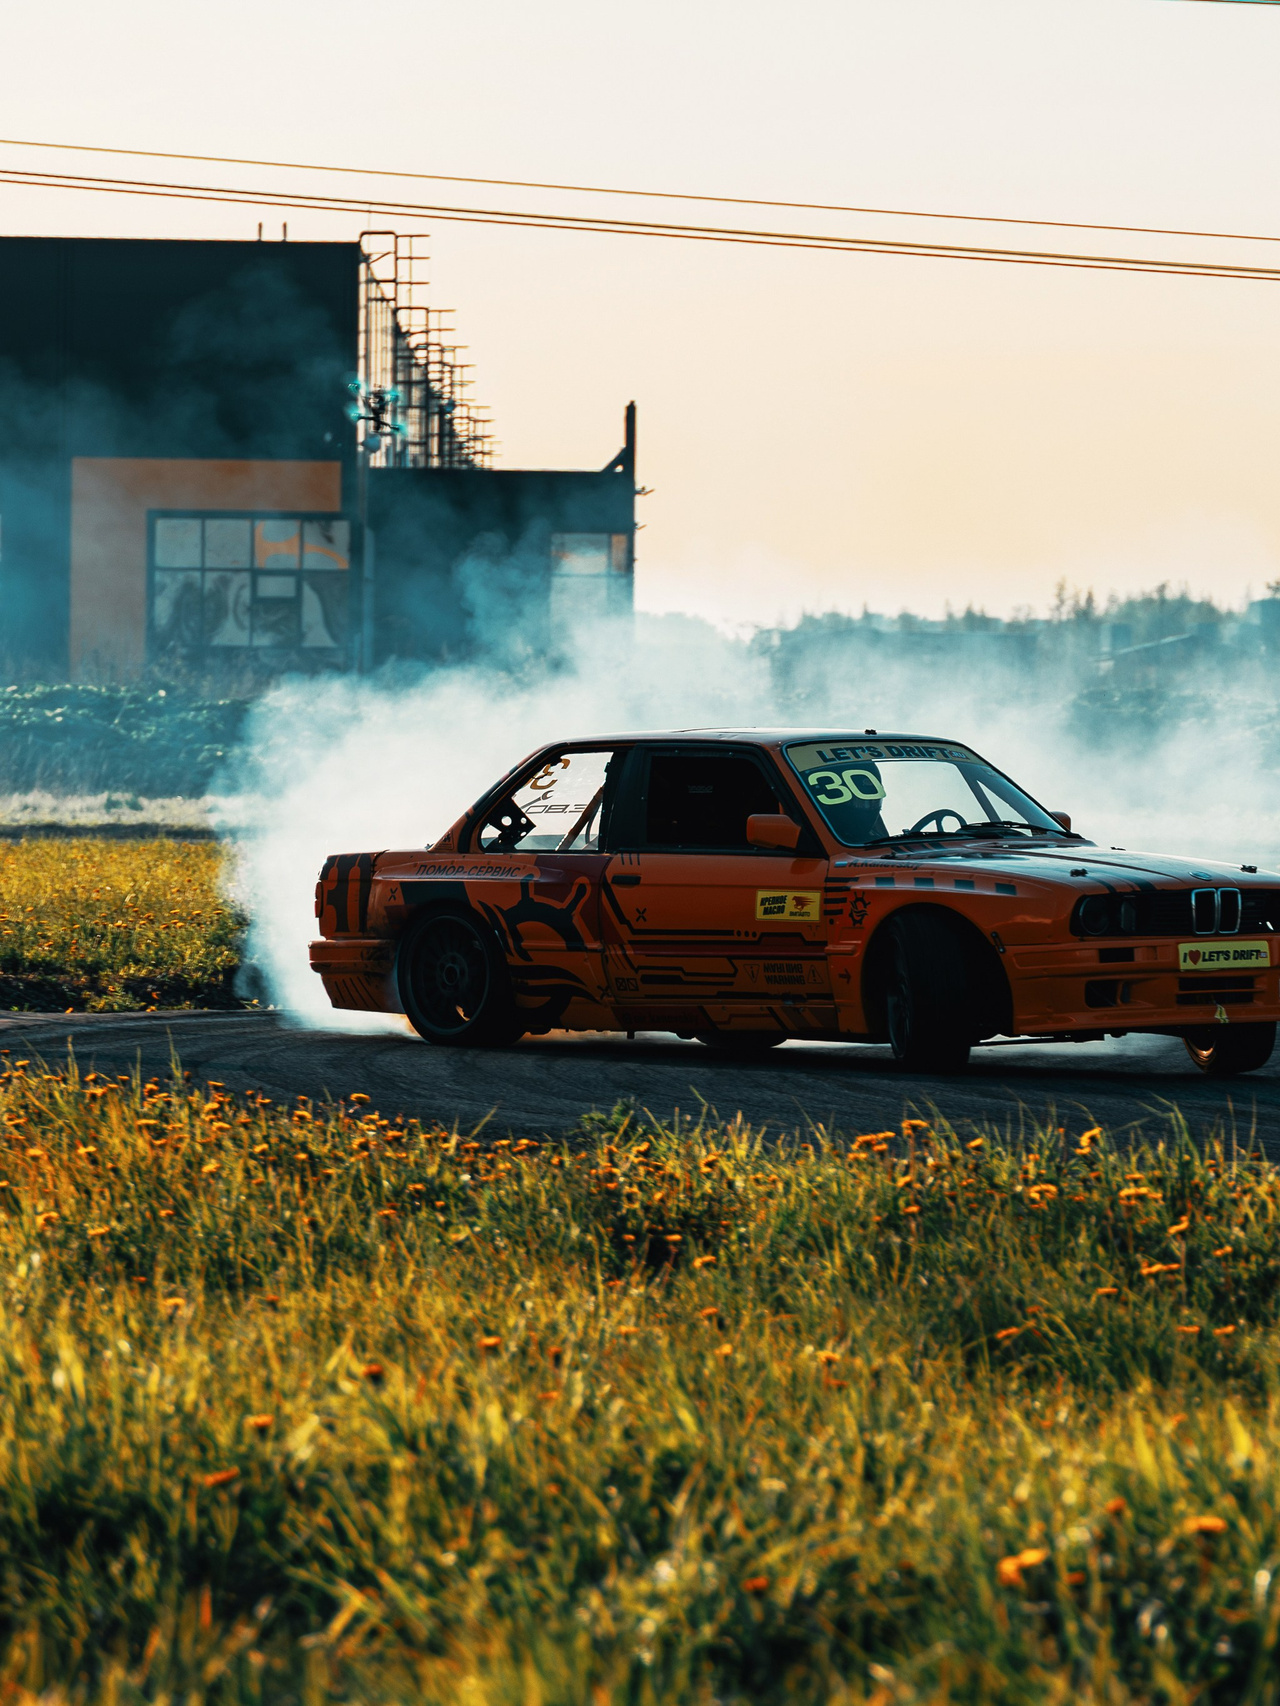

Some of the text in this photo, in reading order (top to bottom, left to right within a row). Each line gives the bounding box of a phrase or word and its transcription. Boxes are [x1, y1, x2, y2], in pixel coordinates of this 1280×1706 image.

[816, 745, 886, 763] LET'S
[808, 769, 886, 805] 30
[416, 864, 521, 877] ПОМОР-СЕРВИС
[1201, 950, 1231, 962] LET'S
